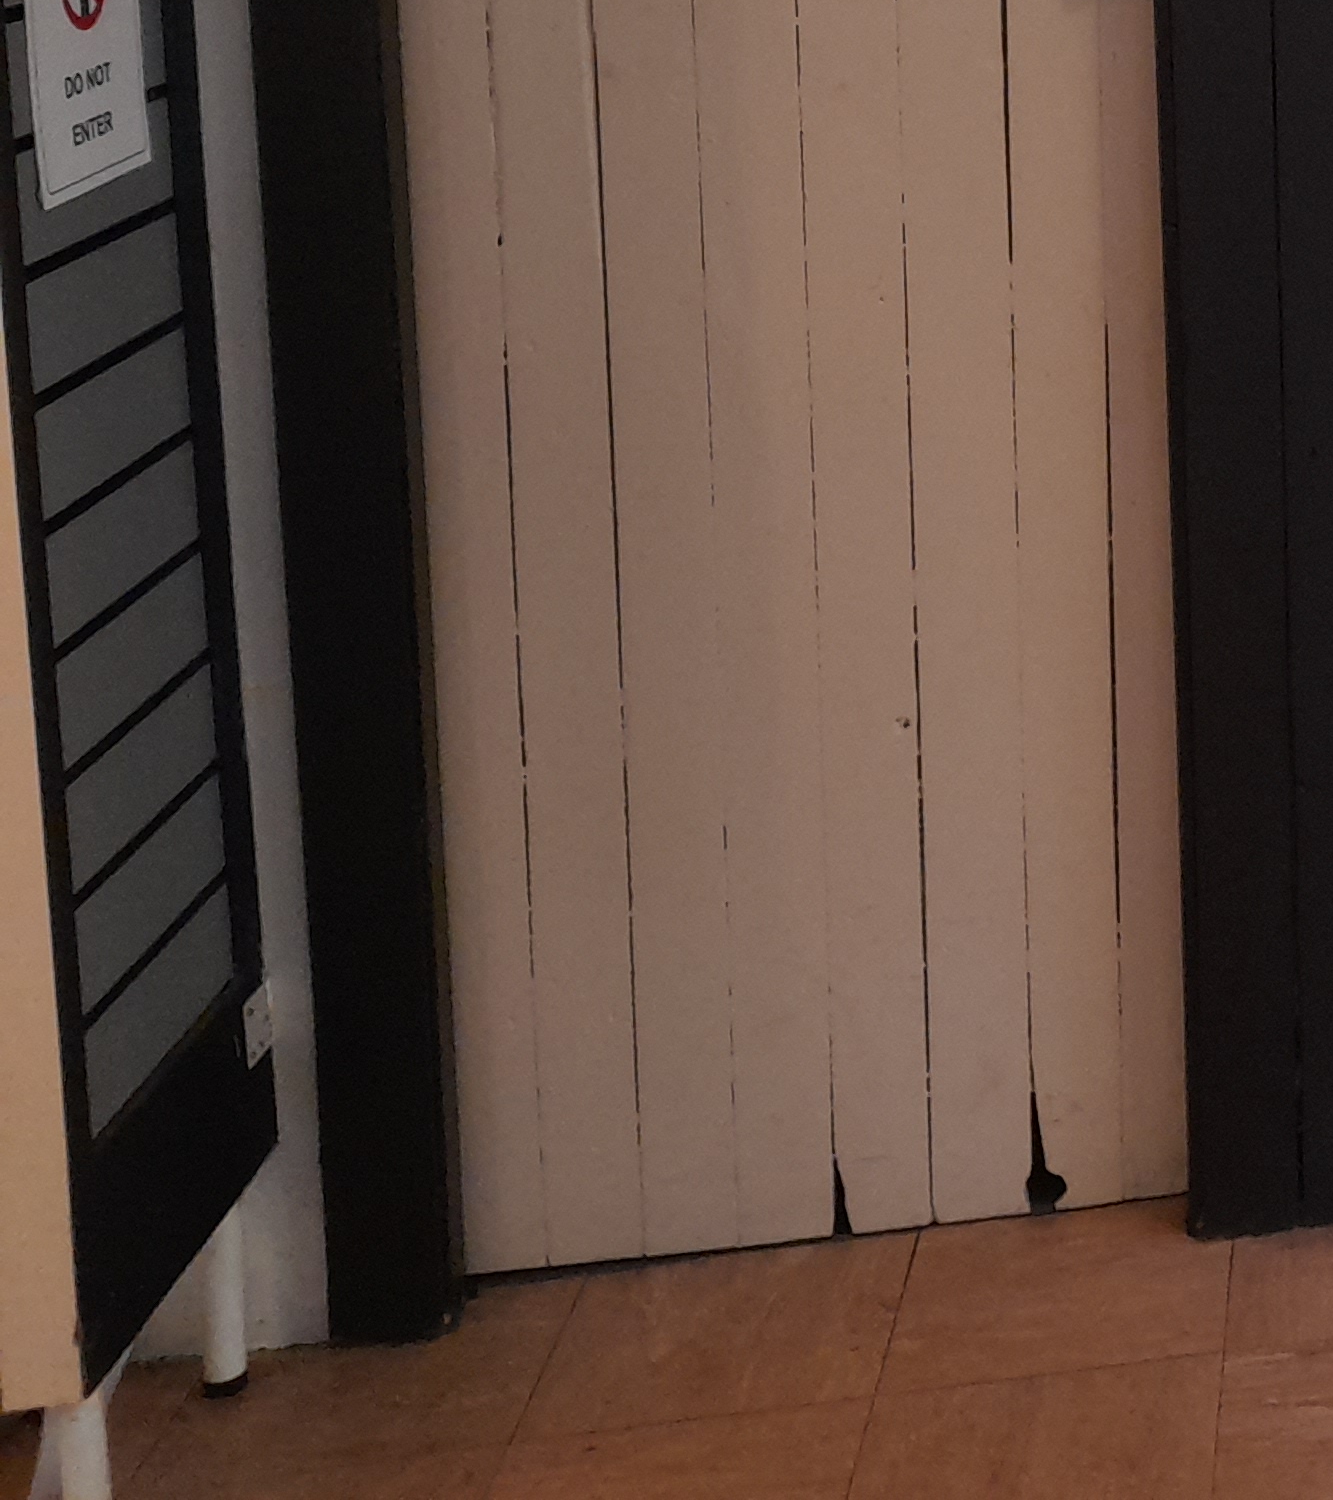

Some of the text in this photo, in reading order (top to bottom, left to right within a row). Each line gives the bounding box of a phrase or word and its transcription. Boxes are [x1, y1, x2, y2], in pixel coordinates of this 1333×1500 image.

[64, 61, 111, 99] DO NOT
[71, 110, 114, 146] ENTER
